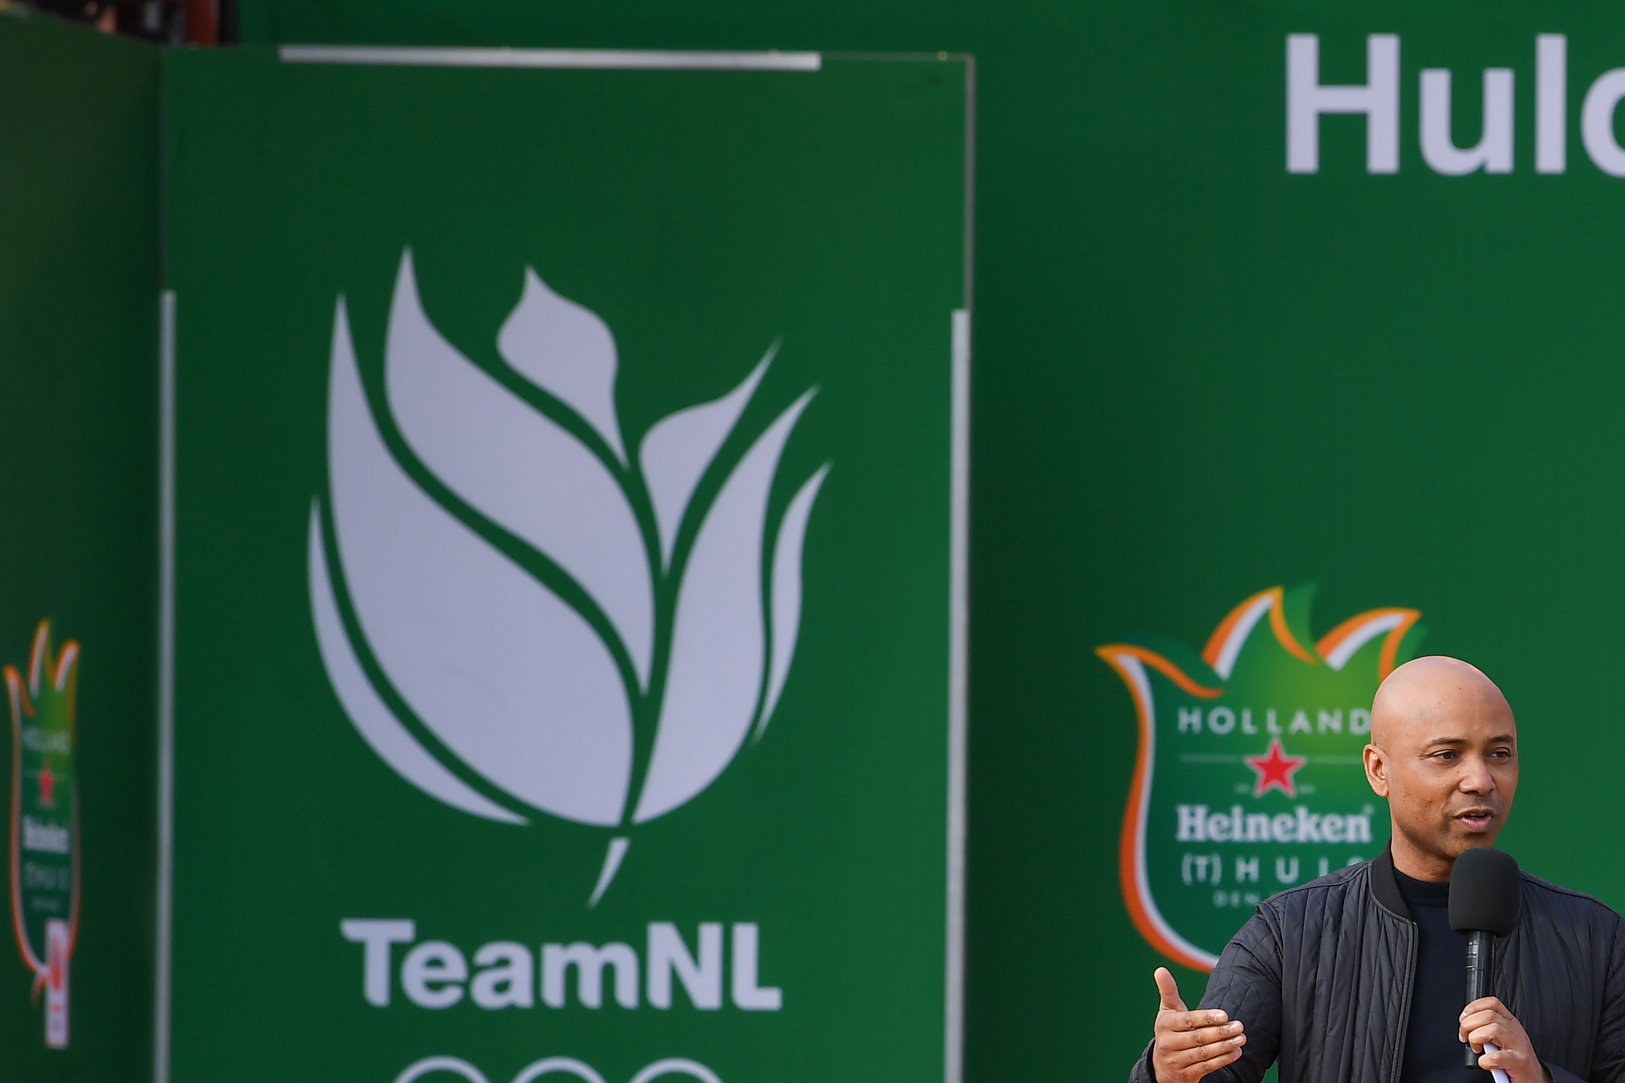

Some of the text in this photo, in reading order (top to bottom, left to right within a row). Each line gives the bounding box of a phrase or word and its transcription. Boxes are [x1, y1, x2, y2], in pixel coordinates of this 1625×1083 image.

[1179, 707, 1371, 737] HOLLAND
[1176, 804, 1373, 844] Heineken
[1181, 853, 1365, 886] (T)HUI
[340, 918, 783, 1011] TeamNL
